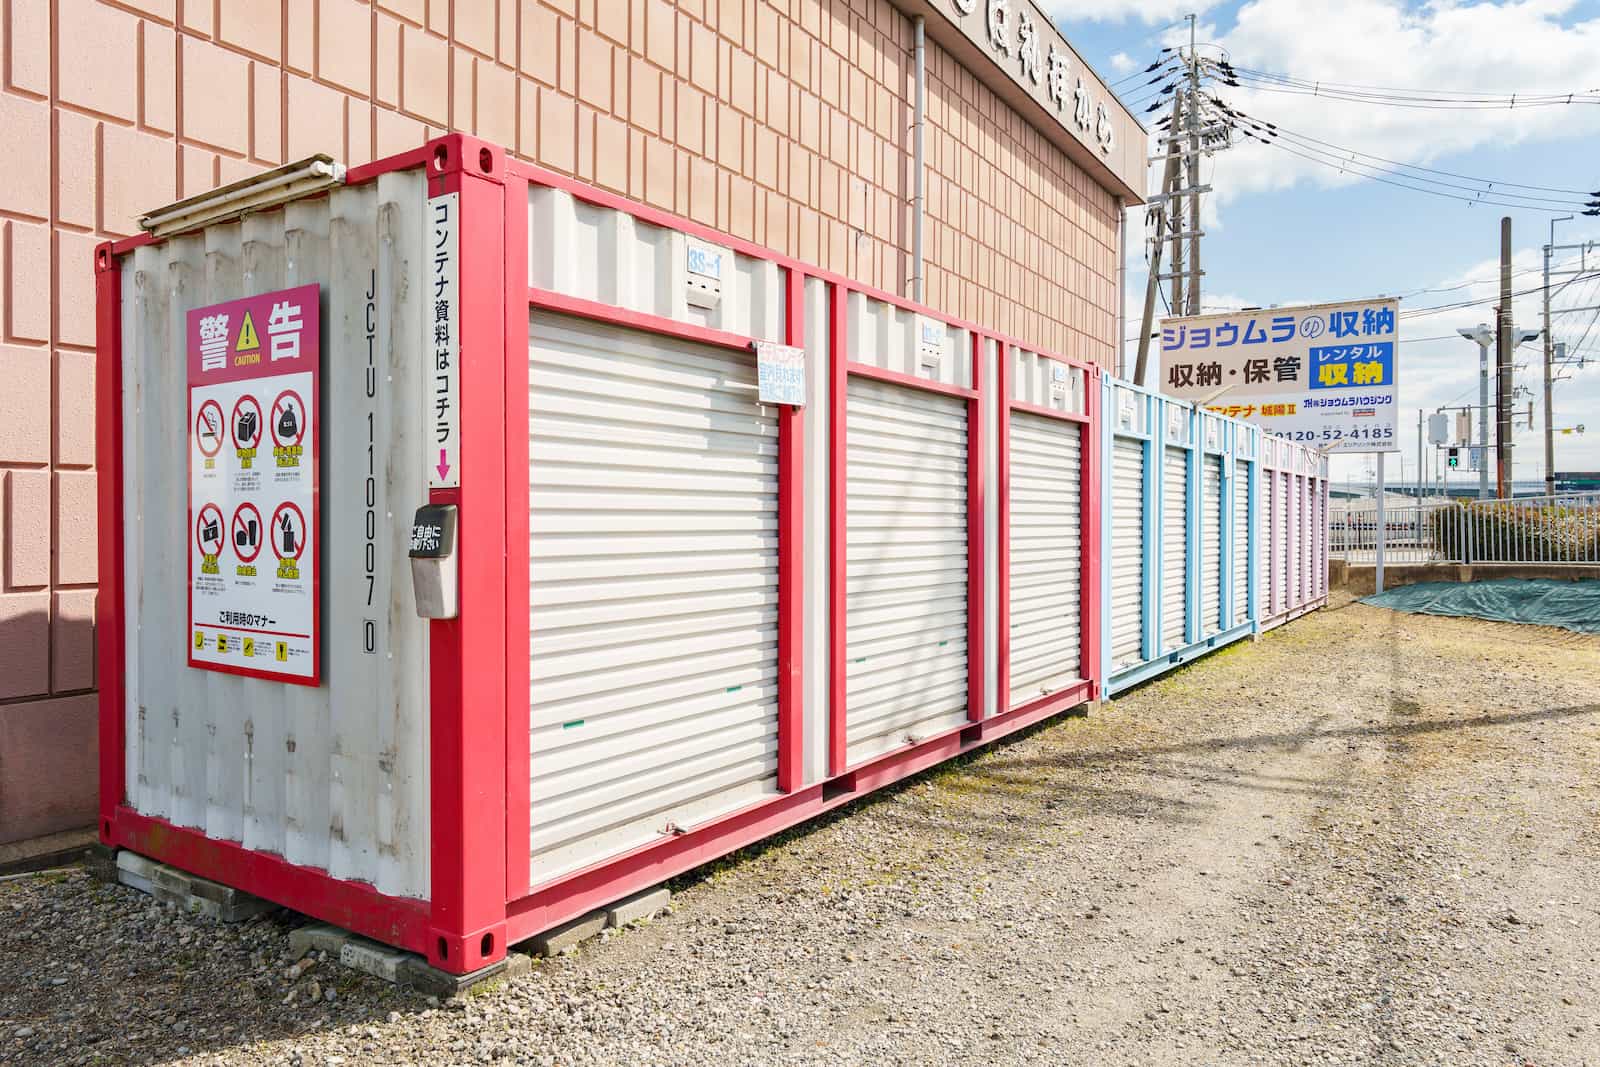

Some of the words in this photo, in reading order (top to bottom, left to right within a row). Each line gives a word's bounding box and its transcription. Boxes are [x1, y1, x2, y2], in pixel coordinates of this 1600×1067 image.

[366, 268, 375, 398] JCTU
[435, 204, 450, 443] コンテナ資料はコチラ
[1163, 307, 1395, 350] ジョウムラの収納
[235, 353, 260, 366] CAUTION
[1318, 346, 1383, 362] レンタル
[1168, 356, 1301, 388] 収納・保管
[1318, 361, 1384, 386] 収納
[1206, 404, 1257, 418] ンテナ
[1275, 428, 1393, 441] 0120-52-4185
[366, 412, 375, 606] 110007
[219, 610, 277, 628] ご利用時のマナー
